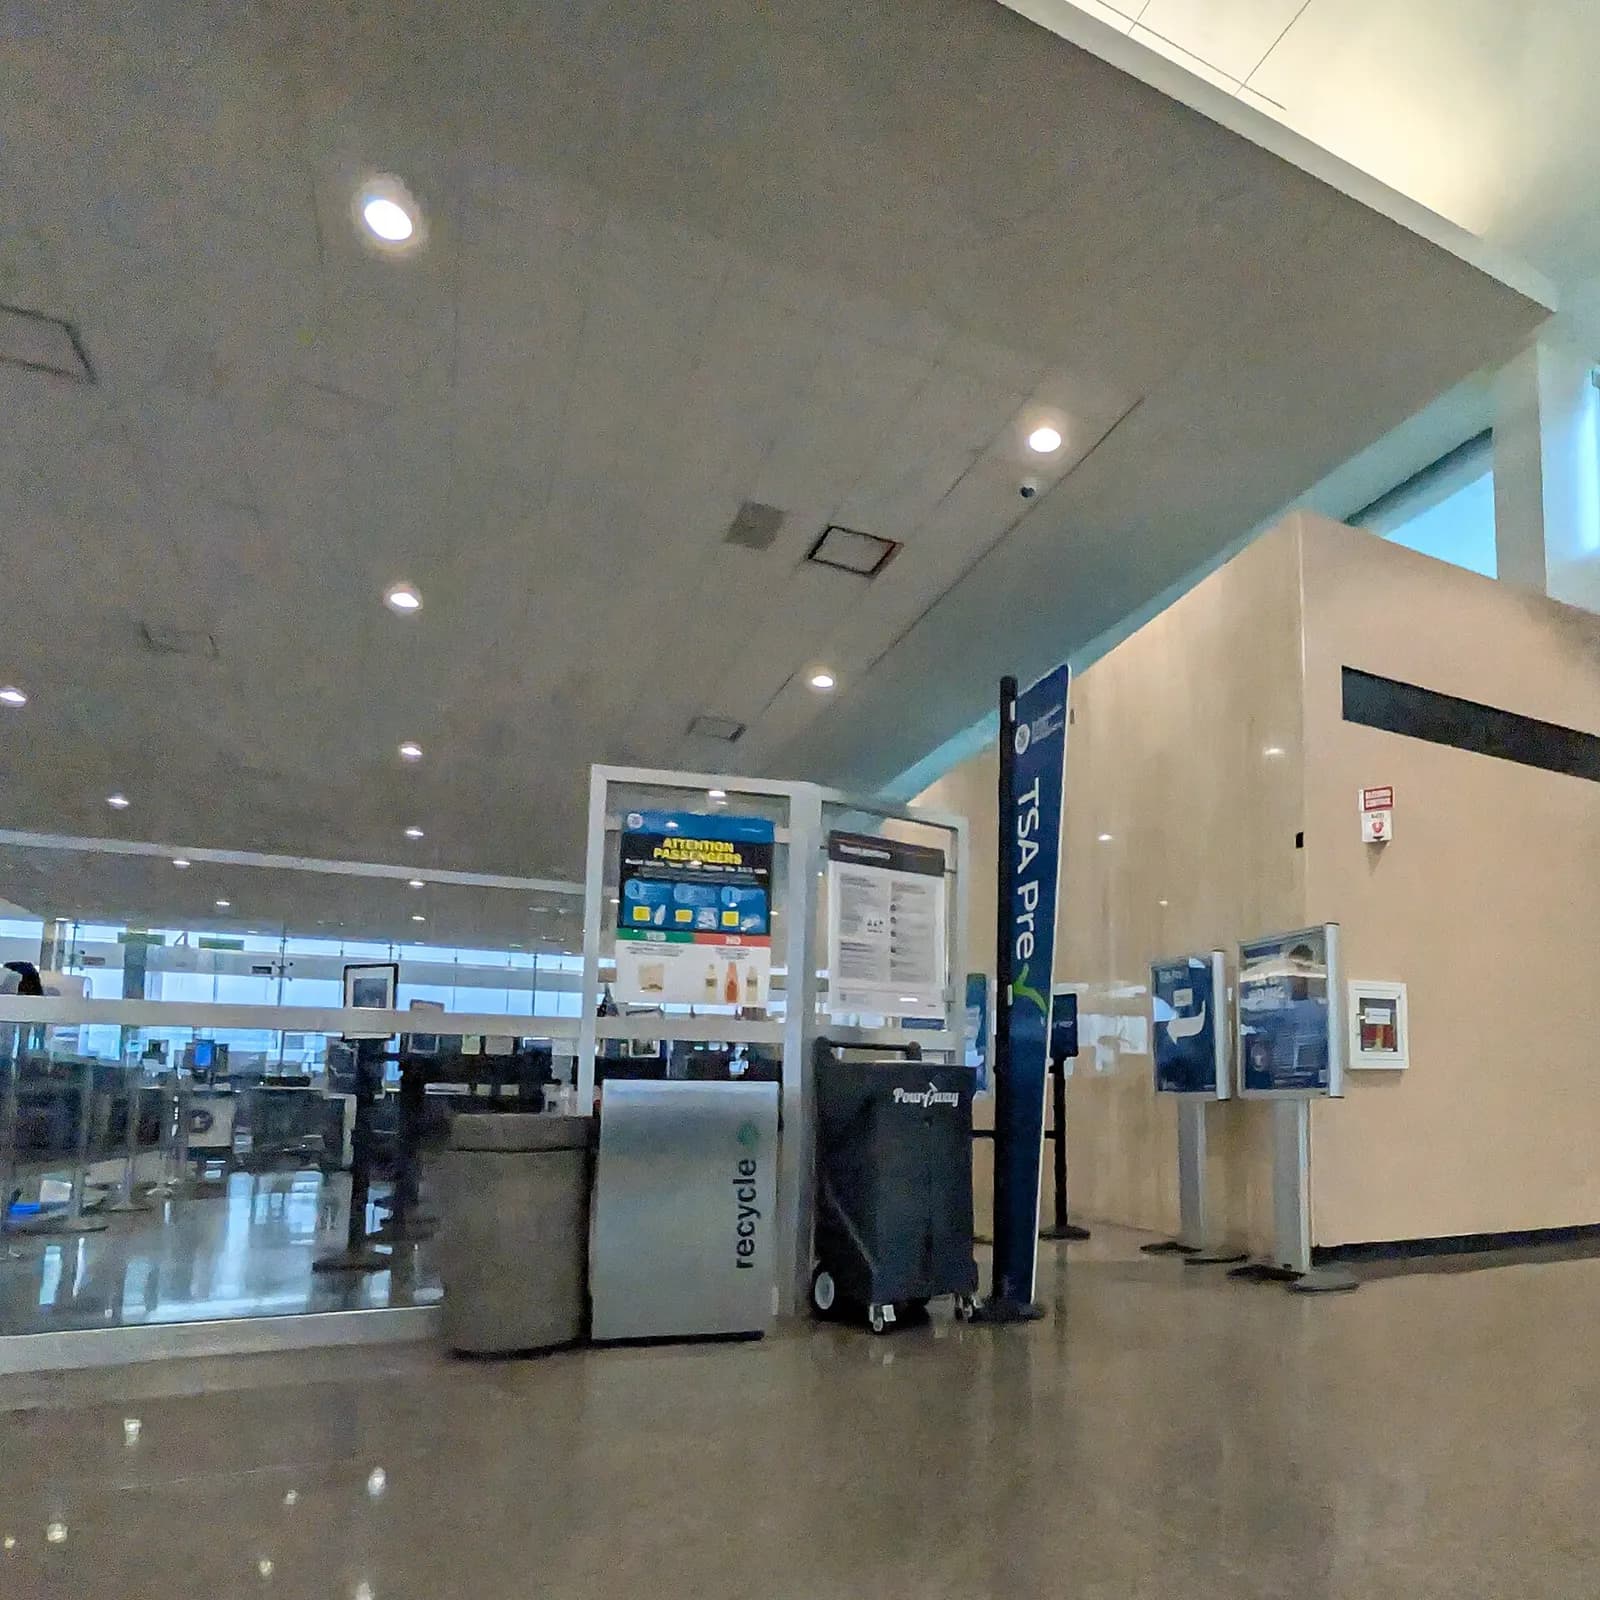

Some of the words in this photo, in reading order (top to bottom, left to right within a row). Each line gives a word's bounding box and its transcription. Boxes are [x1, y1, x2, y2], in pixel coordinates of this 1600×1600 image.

[663, 837, 734, 854] ATTENTION
[1017, 777, 1040, 875] TSA
[653, 847, 743, 865] PASSENGERS
[725, 935, 742, 946] NO
[1015, 879, 1040, 961] Pre
[732, 1158, 762, 1270] recycle
